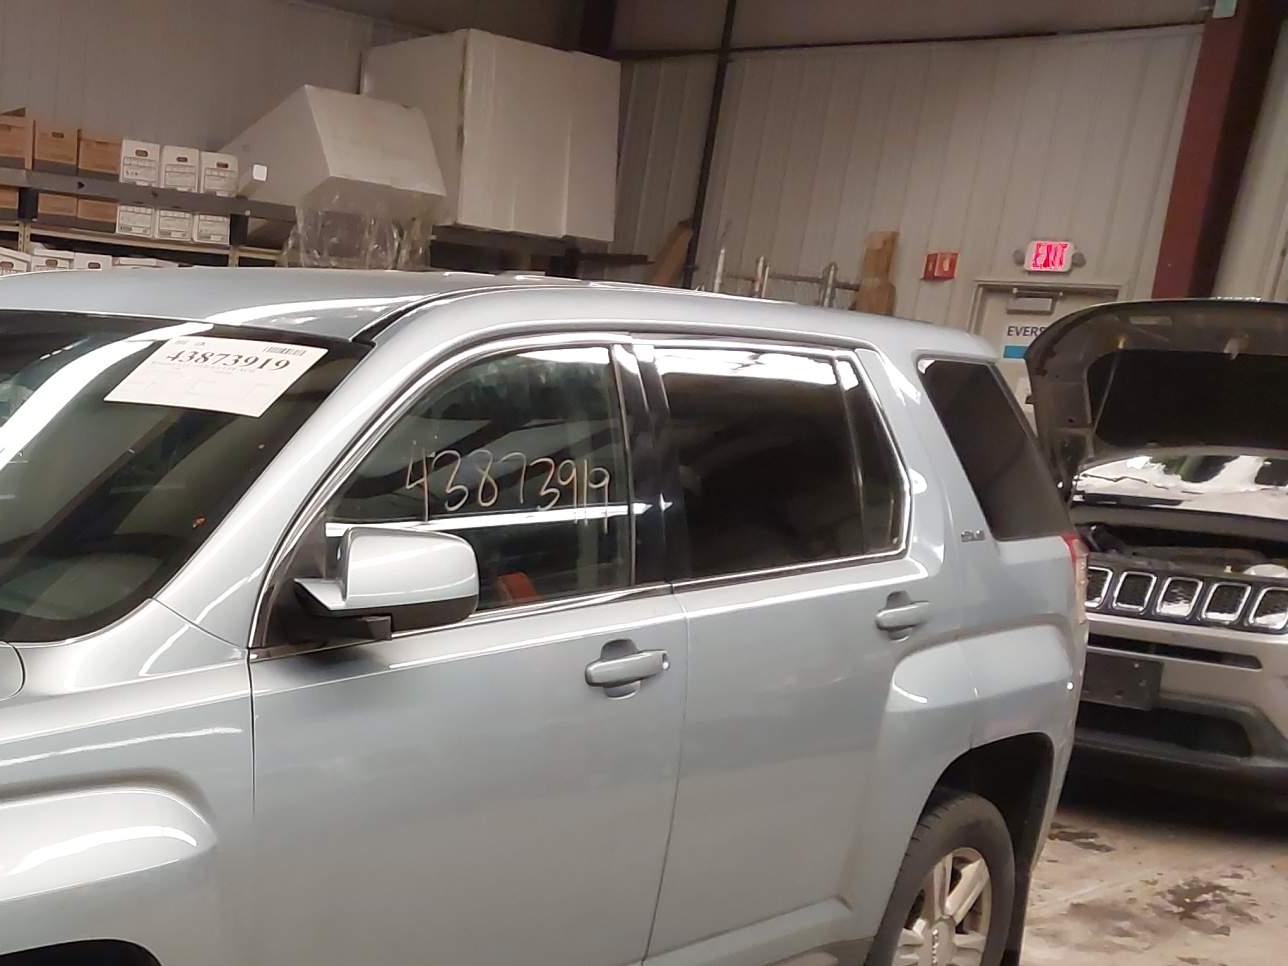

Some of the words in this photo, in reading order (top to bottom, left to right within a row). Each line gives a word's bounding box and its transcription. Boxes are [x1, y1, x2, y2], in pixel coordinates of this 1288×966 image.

[1032, 242, 1069, 268] EXIT
[166, 349, 291, 371] 43873919
[406, 448, 610, 534] 43873919
